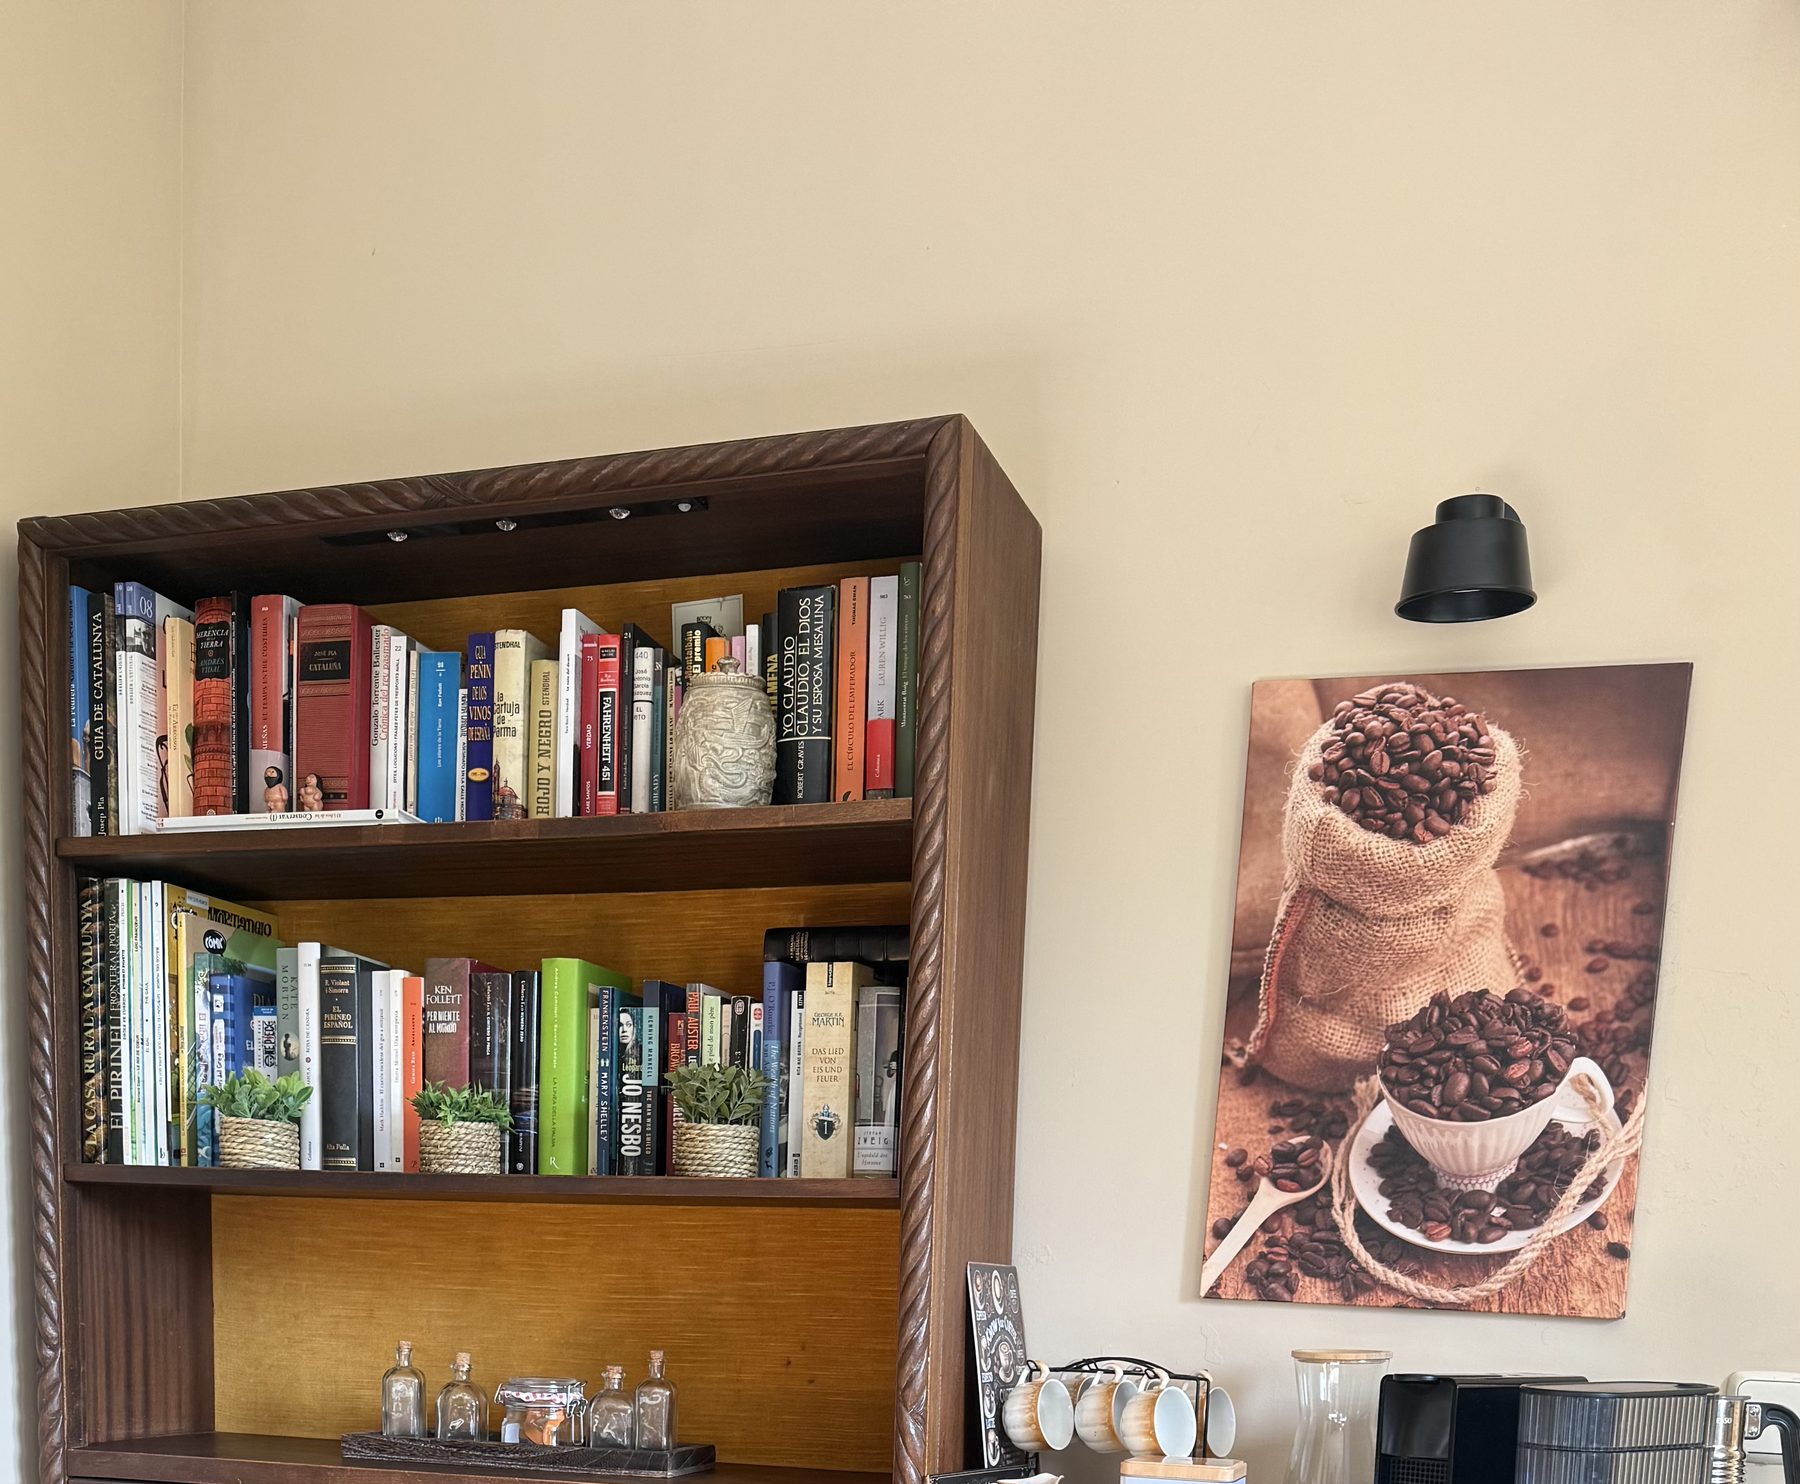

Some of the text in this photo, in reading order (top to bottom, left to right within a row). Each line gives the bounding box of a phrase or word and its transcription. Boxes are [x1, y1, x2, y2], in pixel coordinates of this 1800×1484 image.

[140, 596, 153, 618] 08
[685, 631, 693, 680] Montalbán
[693, 629, 702, 674] El premio
[797, 597, 811, 736] CLAUDIO, EL DIOS
[812, 595, 825, 735] Y SU ESPOSA MESALINA
[878, 617, 887, 687] LAUREN WILLIG
[93, 612, 105, 759] GUIA DE CATALUNYA
[371, 629, 381, 746] Gonzalo Torrente Ballester
[379, 628, 390, 741] Crónica del pasmado
[497, 691, 504, 702] la
[782, 636, 795, 736] YO, CLAUDIO
[469, 706, 492, 720] VINOS
[497, 714, 506, 725] de
[846, 650, 857, 771] EL CÍRCULO DEL EMPERADOR
[536, 671, 552, 816] ROJO Y NEGRO STENDHAL
[602, 696, 611, 781] FAHRENHEIT 451
[797, 741, 805, 799] ROBERT GRAVES
[652, 772, 660, 805] BRADY
[97, 797, 106, 836] Josep Pla
[207, 906, 272, 937] MORTADELO
[281, 964, 290, 1020] MORTON
[425, 993, 463, 1005] FOLLETT
[434, 985, 452, 995] KEN
[687, 992, 699, 1014] PAUL
[81, 899, 97, 1146] LA CASA RURAL A CATALUNYA
[323, 1020, 353, 1030] ESPAÑOL
[324, 1013, 352, 1022] PIRINEO
[426, 1010, 438, 1022] PER
[428, 1022, 457, 1034] AL MONDO
[812, 1017, 845, 1028] MARTIN
[687, 1016, 699, 1051] AUSTER
[707, 1035, 714, 1043] de
[600, 989, 609, 1142] FRANKENSTEIN MARY SHELLEY
[707, 1044, 716, 1057] pied
[828, 1047, 845, 1055] LIED
[621, 1074, 642, 1097] JO
[769, 1044, 779, 1133] The Wealth of Nations
[816, 1075, 839, 1083] FEUER
[857, 1136, 889, 1145] ZWEIG
